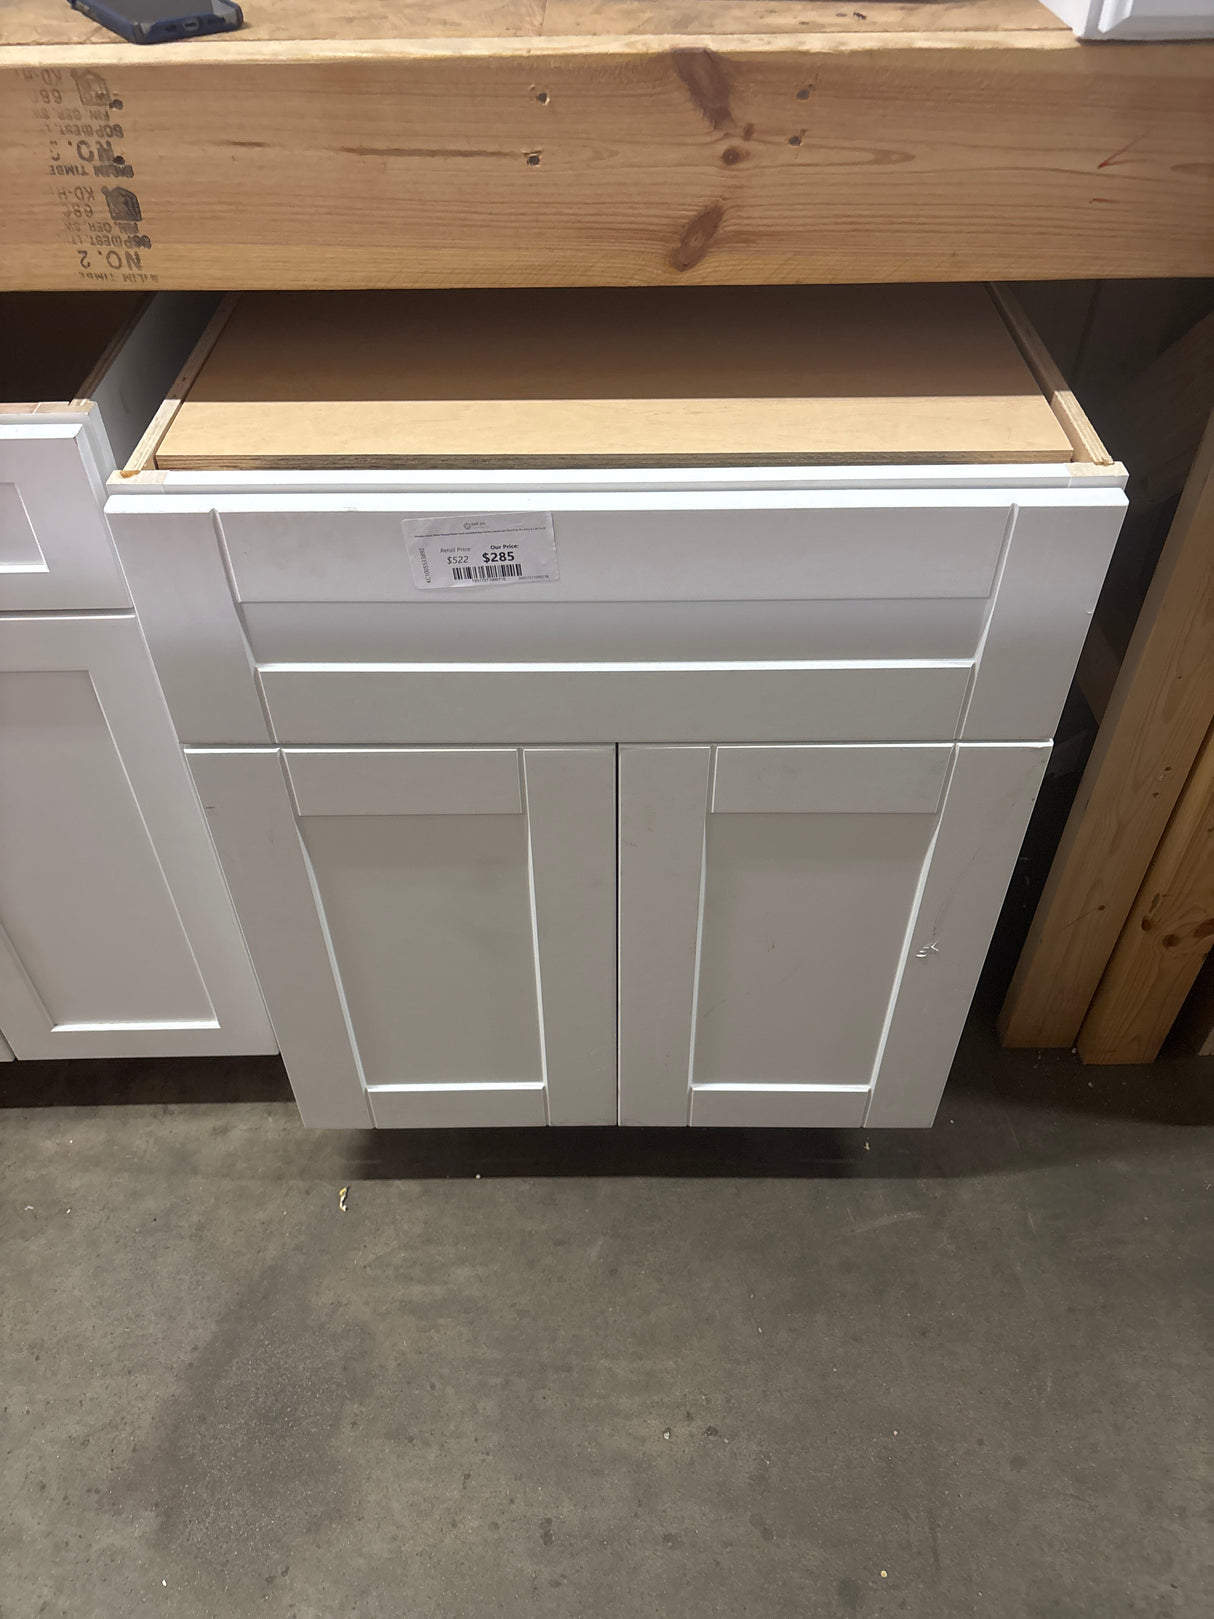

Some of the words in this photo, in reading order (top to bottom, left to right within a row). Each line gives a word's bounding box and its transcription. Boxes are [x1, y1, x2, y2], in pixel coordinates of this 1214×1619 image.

[77, 250, 92, 269] 2
[97, 250, 143, 271] NO.
[446, 555, 469, 565] $522
[482, 551, 515, 564] $285
